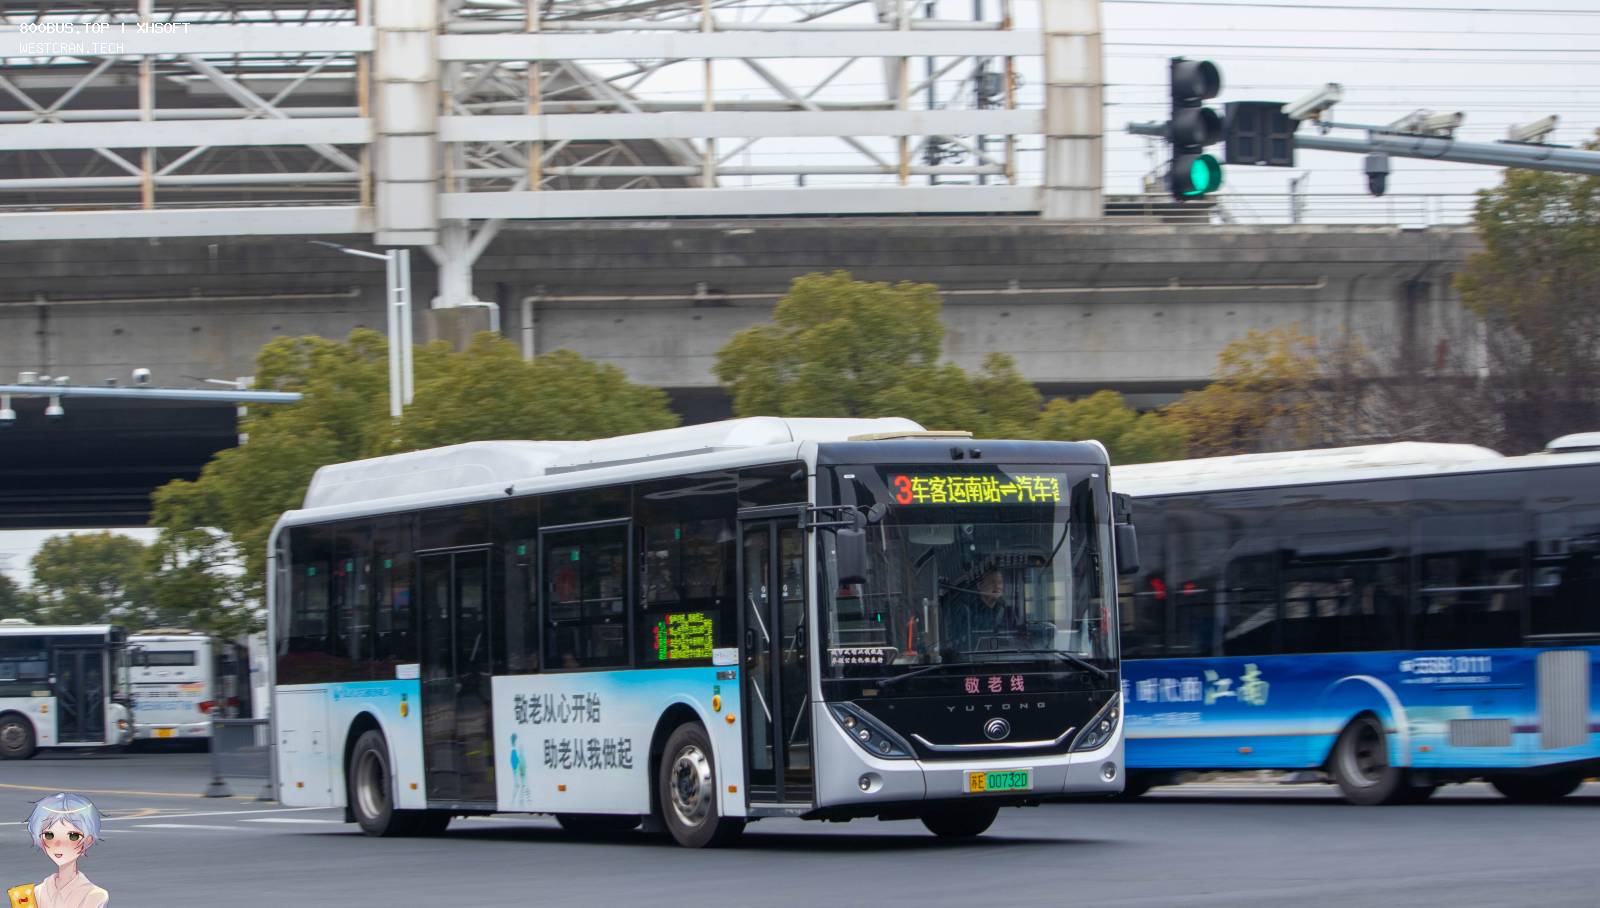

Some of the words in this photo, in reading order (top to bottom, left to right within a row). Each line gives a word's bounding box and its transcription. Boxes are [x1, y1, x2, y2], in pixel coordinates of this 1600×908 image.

[894, 475, 912, 505] 3
[965, 674, 1025, 694] 敬老线
[514, 693, 601, 725] 敬老从心开始
[947, 702, 1046, 712] YUTONG
[543, 738, 633, 770] 助老从我做起
